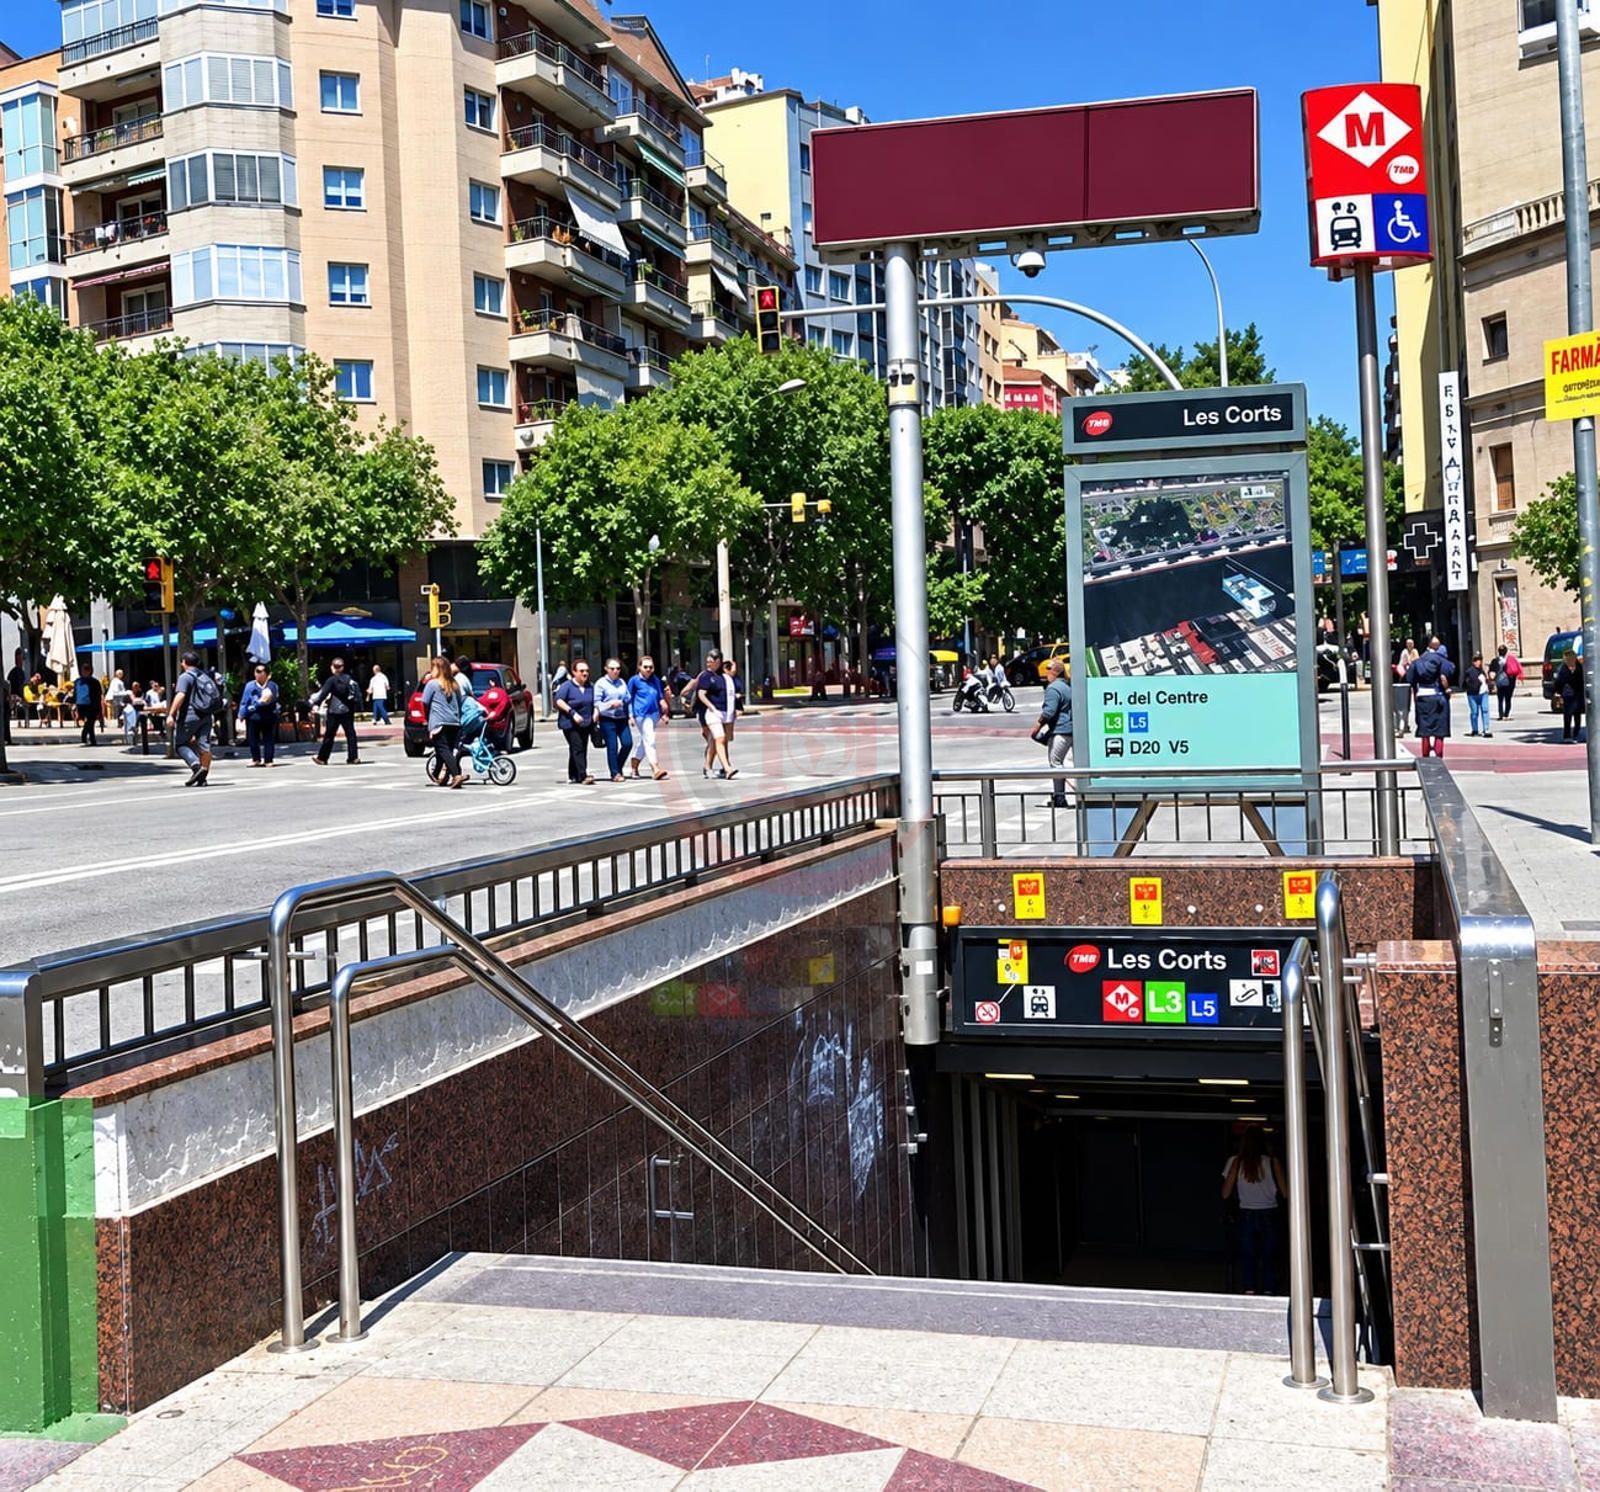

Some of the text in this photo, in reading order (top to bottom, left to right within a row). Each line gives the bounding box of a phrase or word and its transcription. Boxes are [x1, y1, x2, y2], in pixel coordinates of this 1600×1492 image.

[1345, 112, 1385, 148] M
[1393, 165, 1415, 174] TMB
[1183, 405, 1282, 426] Les Corts
[1103, 691, 1208, 706] Pl. del Centre
[1106, 717, 1122, 729] L3
[1130, 740, 1189, 754] D20 V5
[1073, 954, 1096, 963] TMB
[1108, 948, 1227, 969] Les Corts
[1115, 991, 1215, 1016] M L3 L5
